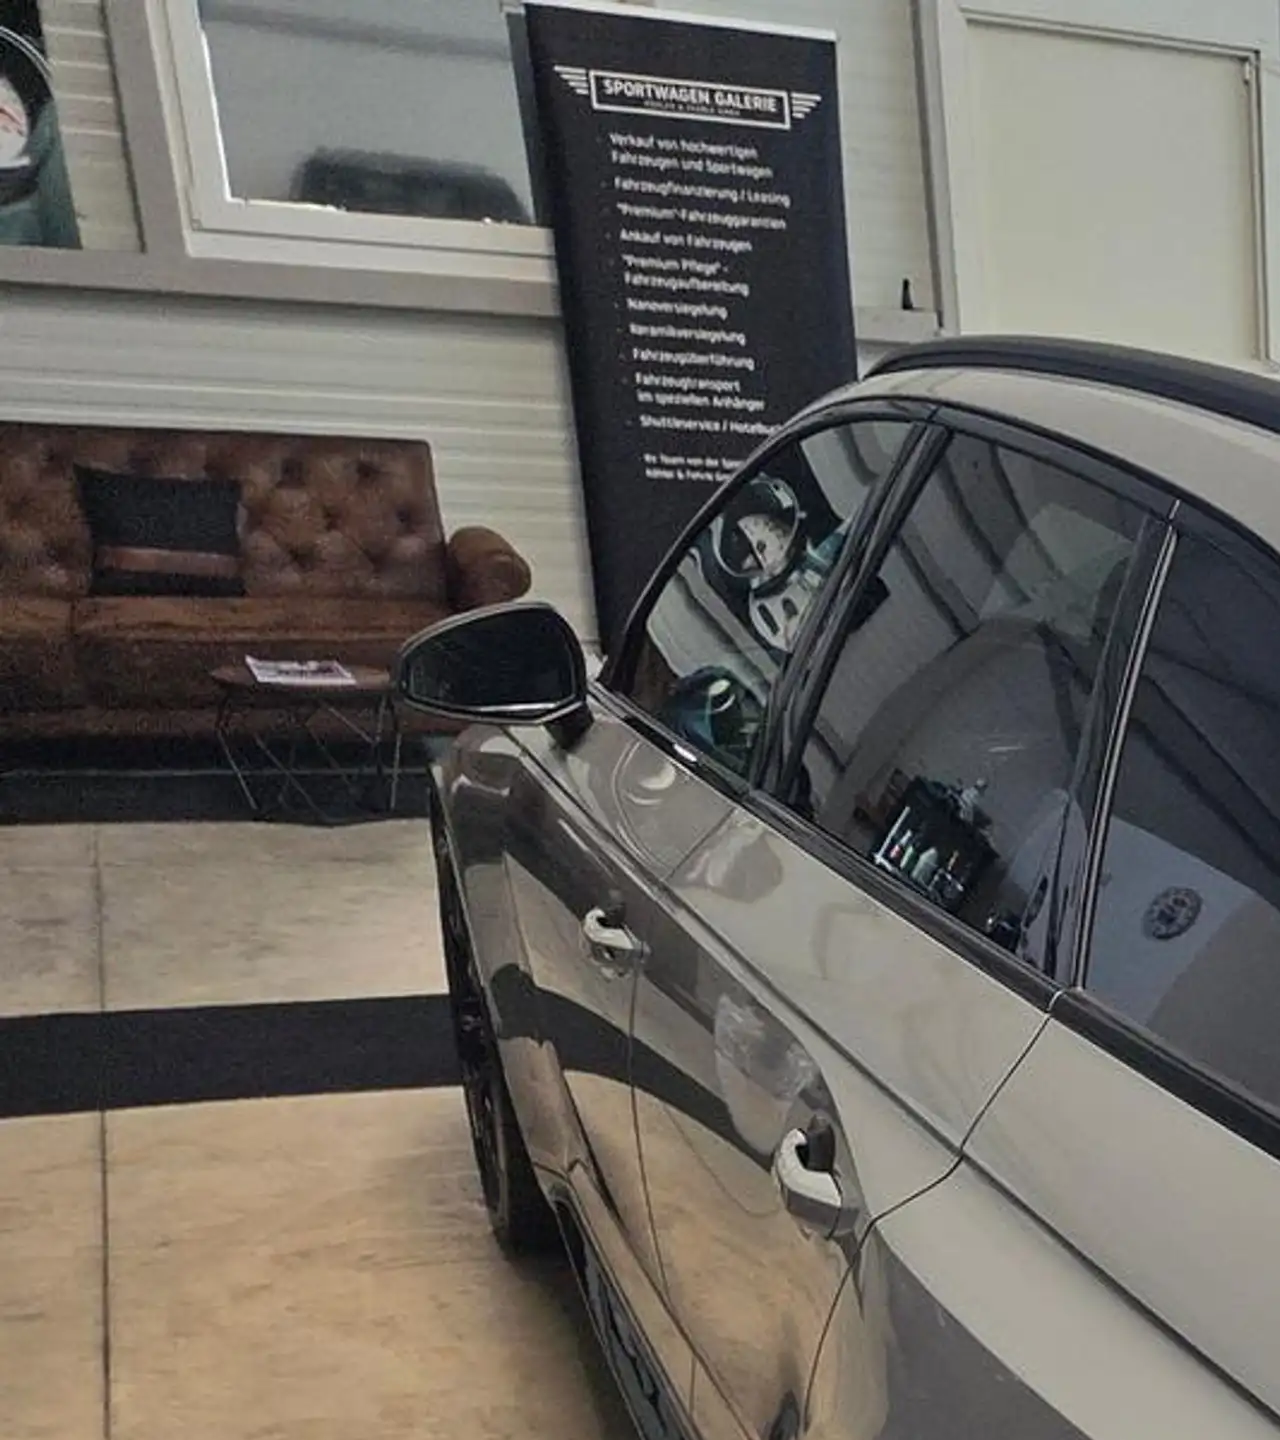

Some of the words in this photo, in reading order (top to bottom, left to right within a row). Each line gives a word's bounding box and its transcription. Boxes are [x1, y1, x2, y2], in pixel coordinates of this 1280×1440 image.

[602, 78, 710, 105] SPORTWAGEN
[714, 91, 777, 112] GALERIE
[610, 132, 656, 149] Verkauf
[658, 139, 679, 150] von
[681, 139, 758, 161] hochwertigen
[612, 151, 679, 171] Fahrzeugen
[682, 156, 703, 172] und
[706, 159, 773, 181] Sportwagen
[614, 176, 739, 203] Fahrzeugfinanzierung
[747, 189, 791, 208] Leasing
[619, 229, 661, 244] Ankauf
[663, 235, 685, 246] von
[686, 234, 752, 254] Fahrzeugen
[624, 271, 750, 297] Fahrzeugaufbereitung
[627, 297, 728, 320] Nanoversiegelung
[629, 322, 747, 346] Keramikversiegelung
[633, 347, 755, 371] Fahrzeugüberführung
[635, 372, 740, 393] Fahrzeugtransport
[637, 390, 653, 402] im
[713, 394, 765, 413] Anhänger
[639, 414, 720, 431] Shuttleservice
